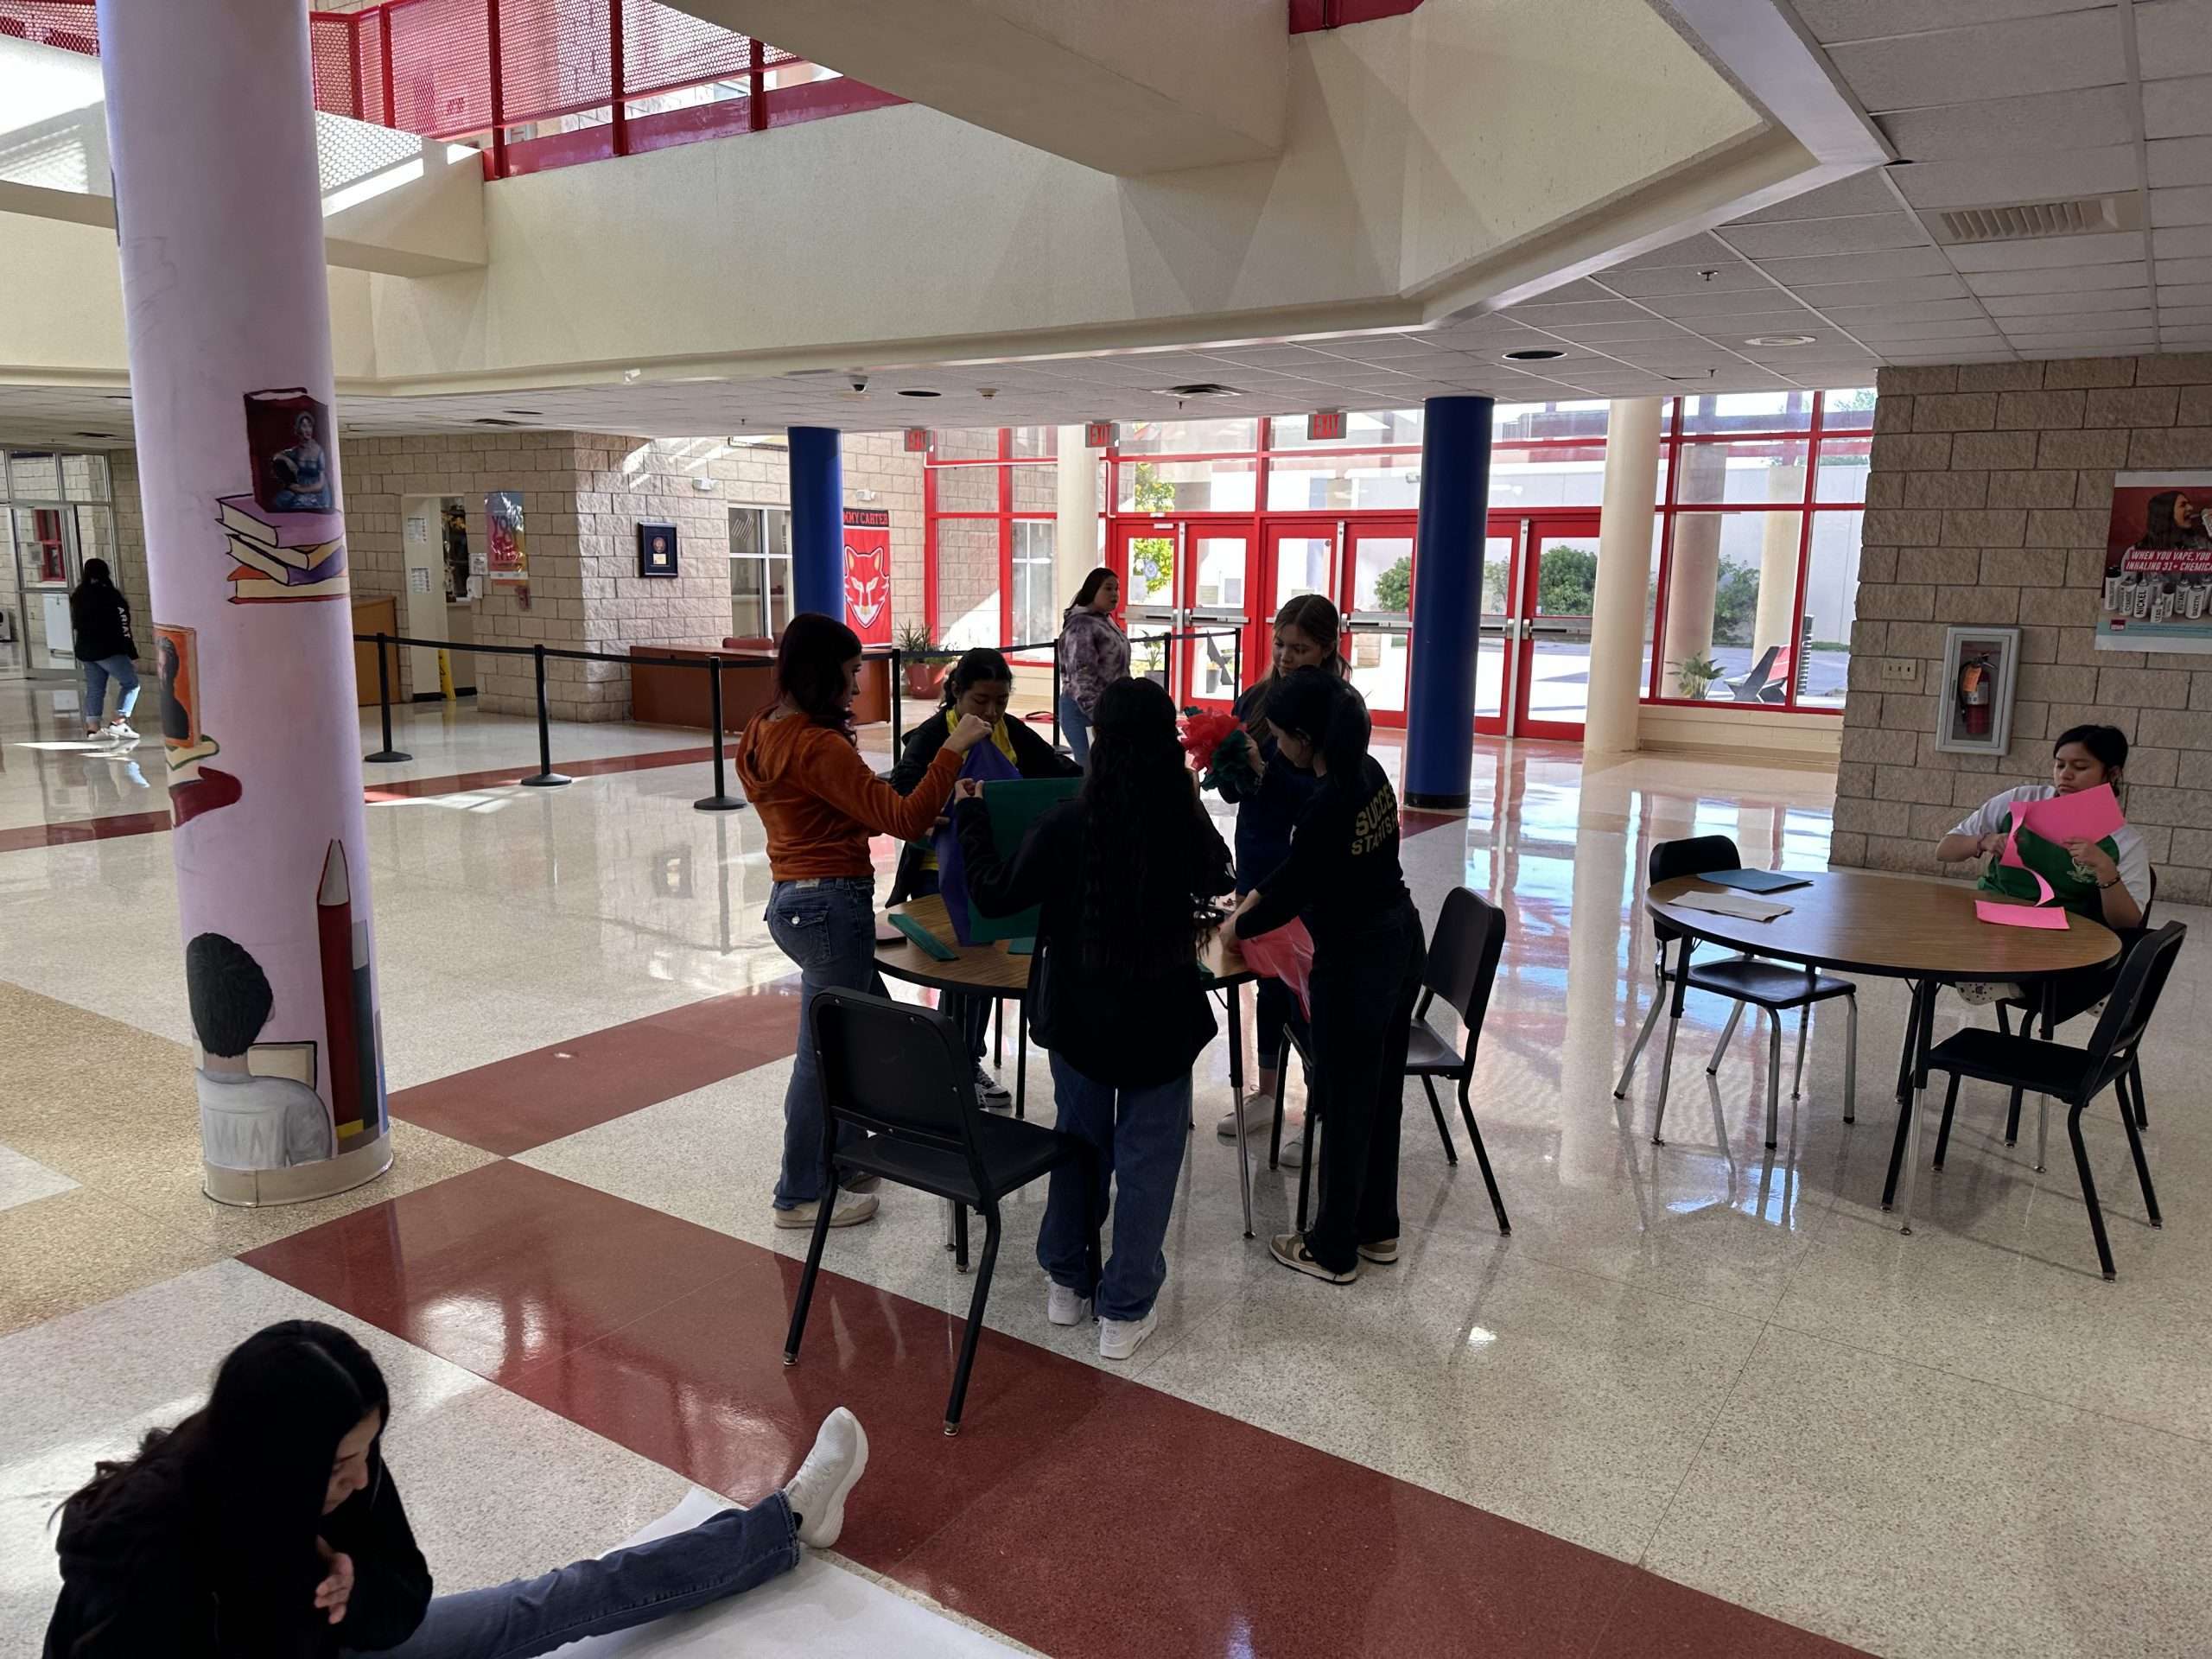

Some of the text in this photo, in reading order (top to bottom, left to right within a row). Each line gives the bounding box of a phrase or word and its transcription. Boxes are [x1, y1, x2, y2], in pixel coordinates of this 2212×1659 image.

[1090, 423, 1112, 445] EXIT
[1313, 415, 1340, 437] EXIT
[908, 429, 927, 450] EXIT
[859, 512, 888, 526] CARTER
[2126, 561, 2162, 571] INHALING
[2131, 550, 2156, 561] WHEN
[2156, 551, 2171, 561] YOU
[2196, 552, 2211, 562] YOU
[2136, 589, 2146, 615] NICKEL
[117, 607, 131, 639] ARIAT
